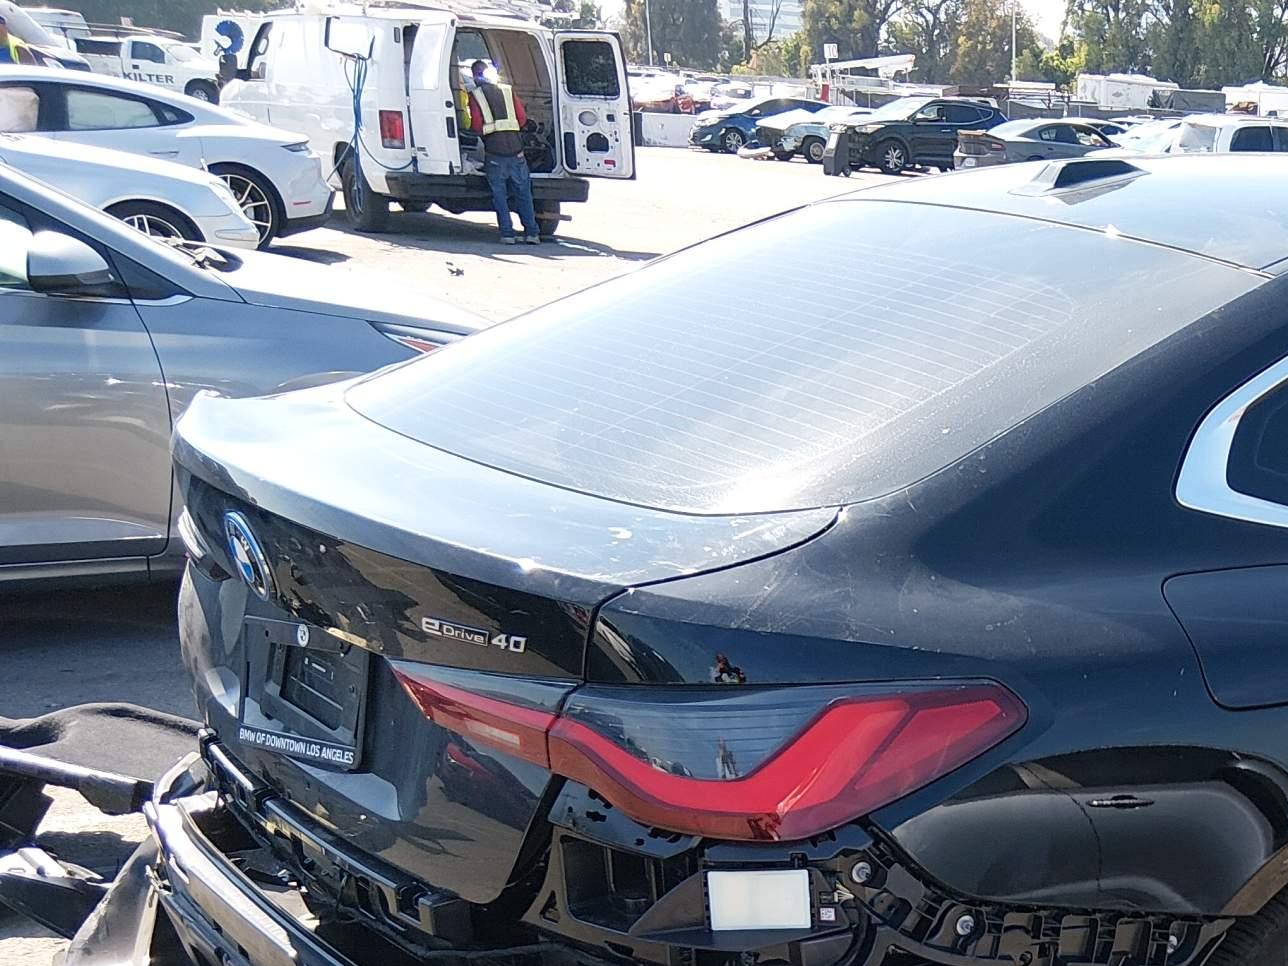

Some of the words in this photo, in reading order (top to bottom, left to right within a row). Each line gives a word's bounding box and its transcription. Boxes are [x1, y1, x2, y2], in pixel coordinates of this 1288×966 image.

[122, 72, 174, 84] KILTER
[491, 633, 528, 653] 40
[239, 728, 256, 743] BMW
[256, 732, 266, 744] OF
[265, 734, 306, 754] DOWNTOWN
[306, 744, 321, 757] LOS
[321, 747, 354, 764] ANGELES
